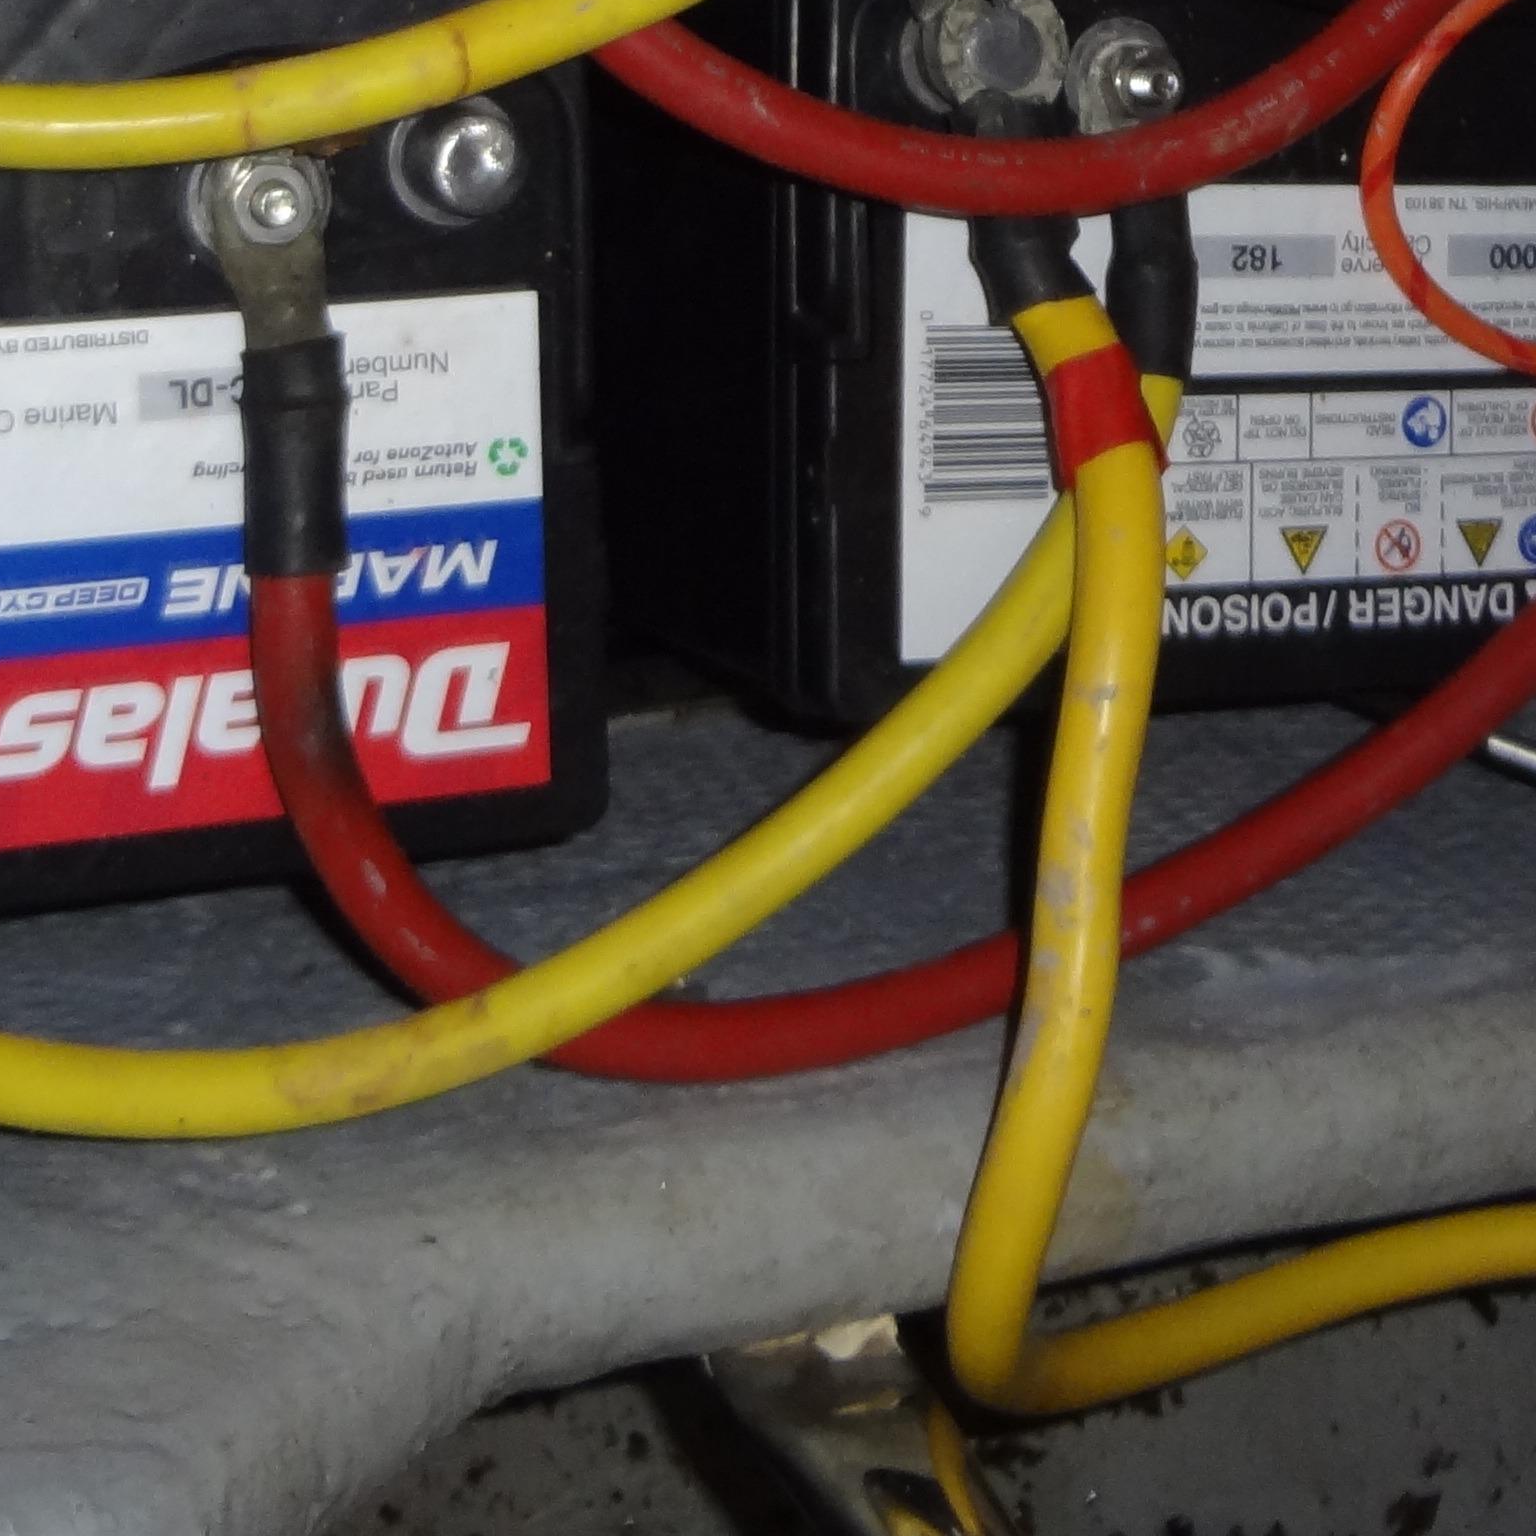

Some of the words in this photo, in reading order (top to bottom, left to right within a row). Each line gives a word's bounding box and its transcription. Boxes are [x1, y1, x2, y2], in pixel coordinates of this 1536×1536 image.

[1229, 244, 1283, 271] 182
[23, 327, 148, 352] DISTRIBUTED
[23, 400, 118, 431] Marine
[386, 439, 477, 464] AutoZone
[363, 465, 407, 486] used
[414, 459, 478, 480] Return
[155, 538, 498, 622] MARNE
[53, 581, 141, 610] DEEP
[1347, 580, 1514, 628] DANGER
